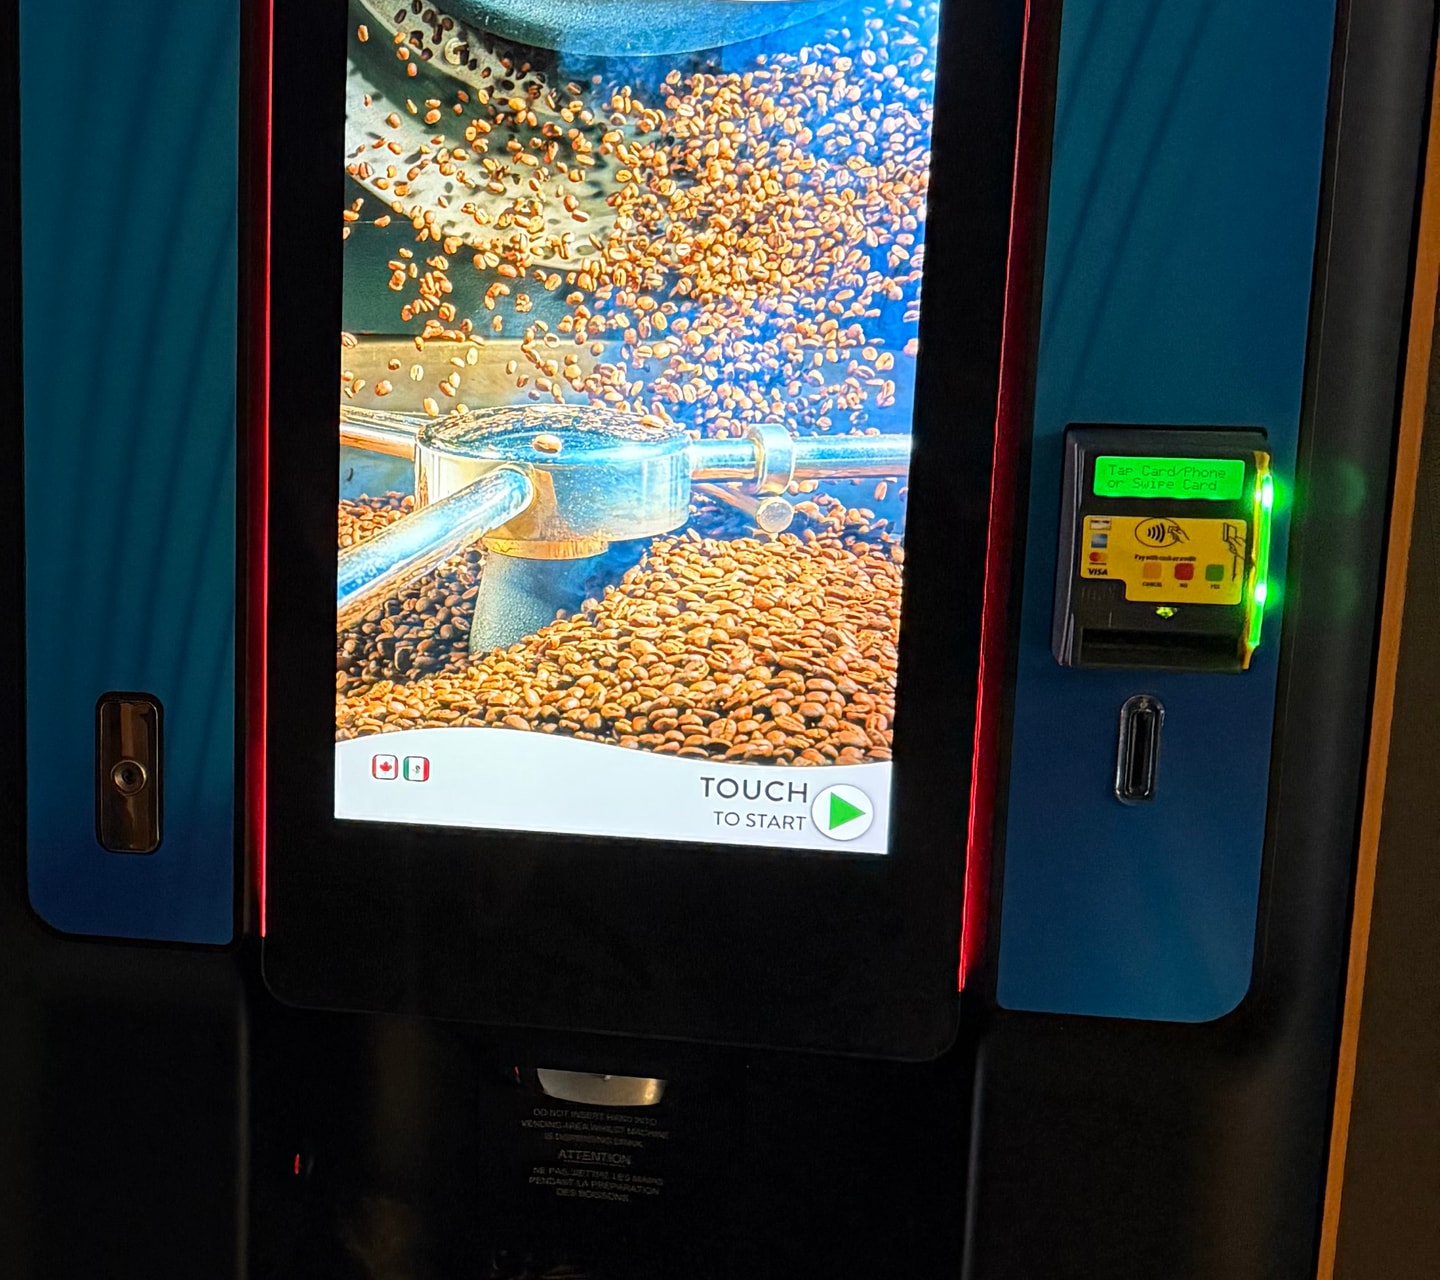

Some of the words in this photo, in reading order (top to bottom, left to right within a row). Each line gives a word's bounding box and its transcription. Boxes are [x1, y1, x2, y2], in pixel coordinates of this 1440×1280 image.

[1109, 464, 1133, 476] Tap
[1142, 465, 1226, 479] Card/Phone
[1107, 479, 1125, 488] or
[1132, 478, 1175, 490] Swipe
[1183, 480, 1217, 491] Card
[700, 776, 809, 804] TOUCH
[713, 809, 740, 827] TO
[745, 811, 807, 831] START
[558, 1149, 632, 1165] ATTENTION
